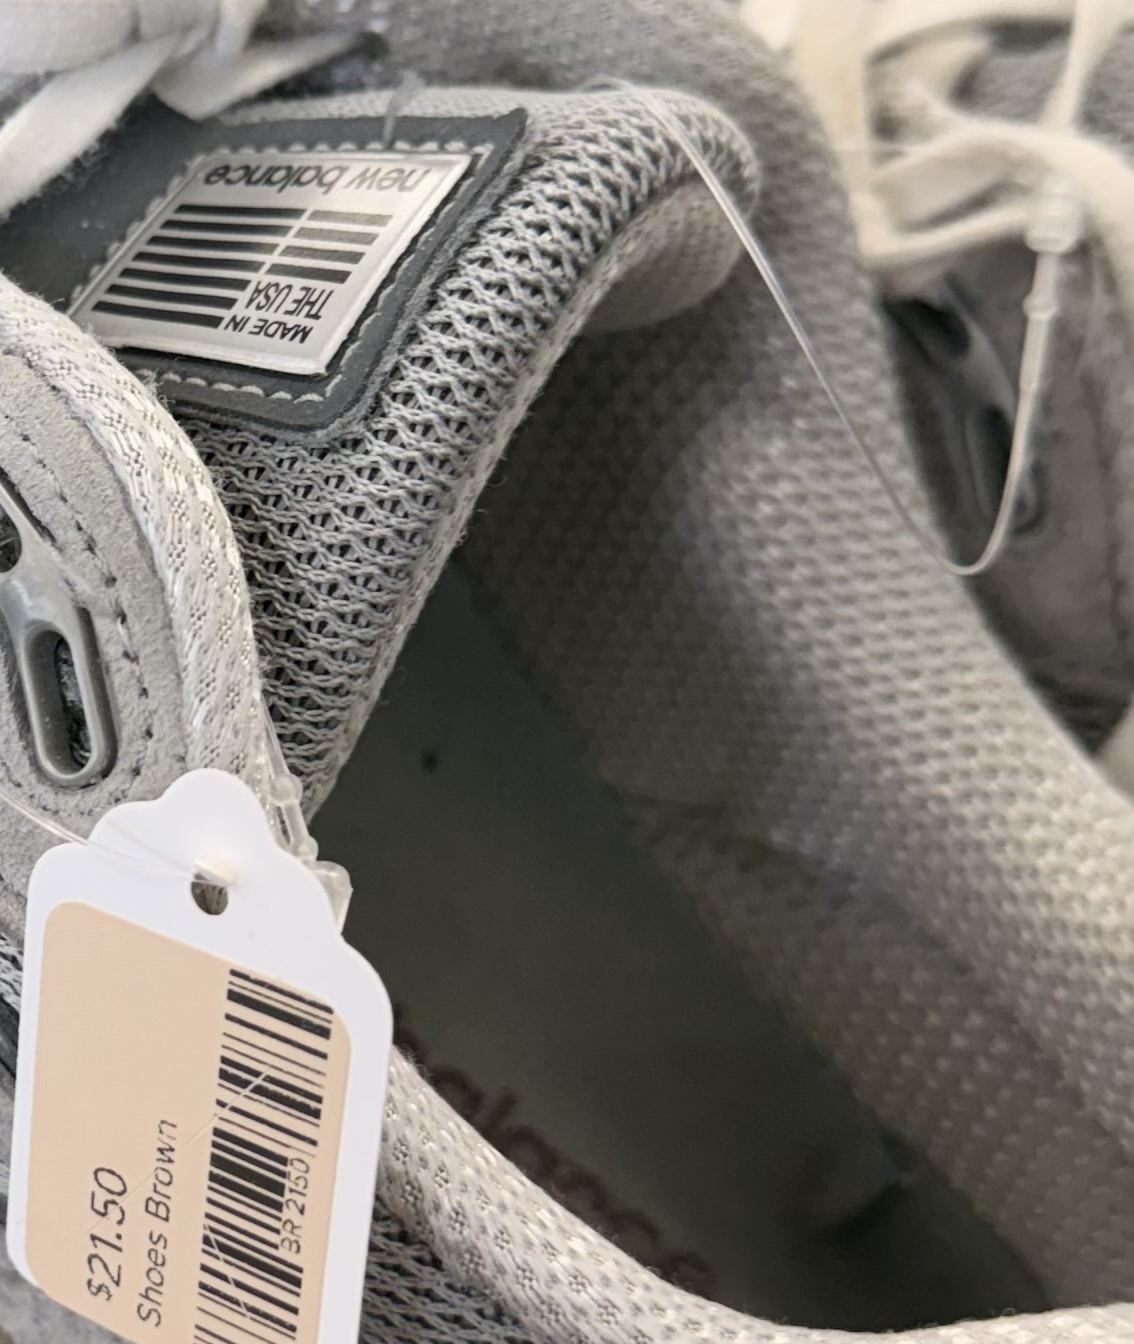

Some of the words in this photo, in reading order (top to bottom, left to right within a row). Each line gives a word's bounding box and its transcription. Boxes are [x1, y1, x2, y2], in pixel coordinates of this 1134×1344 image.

[205, 164, 345, 194] balance
[343, 166, 429, 192] new
[244, 279, 294, 314] USA
[283, 286, 335, 321] THE
[223, 313, 252, 333] IN
[248, 317, 315, 344] MADE
[144, 1119, 178, 1223] Brown
[284, 1156, 311, 1216] 2150
[86, 1166, 128, 1302] $21.50
[279, 1218, 303, 1255] BR
[136, 1229, 168, 1328] Shoes
